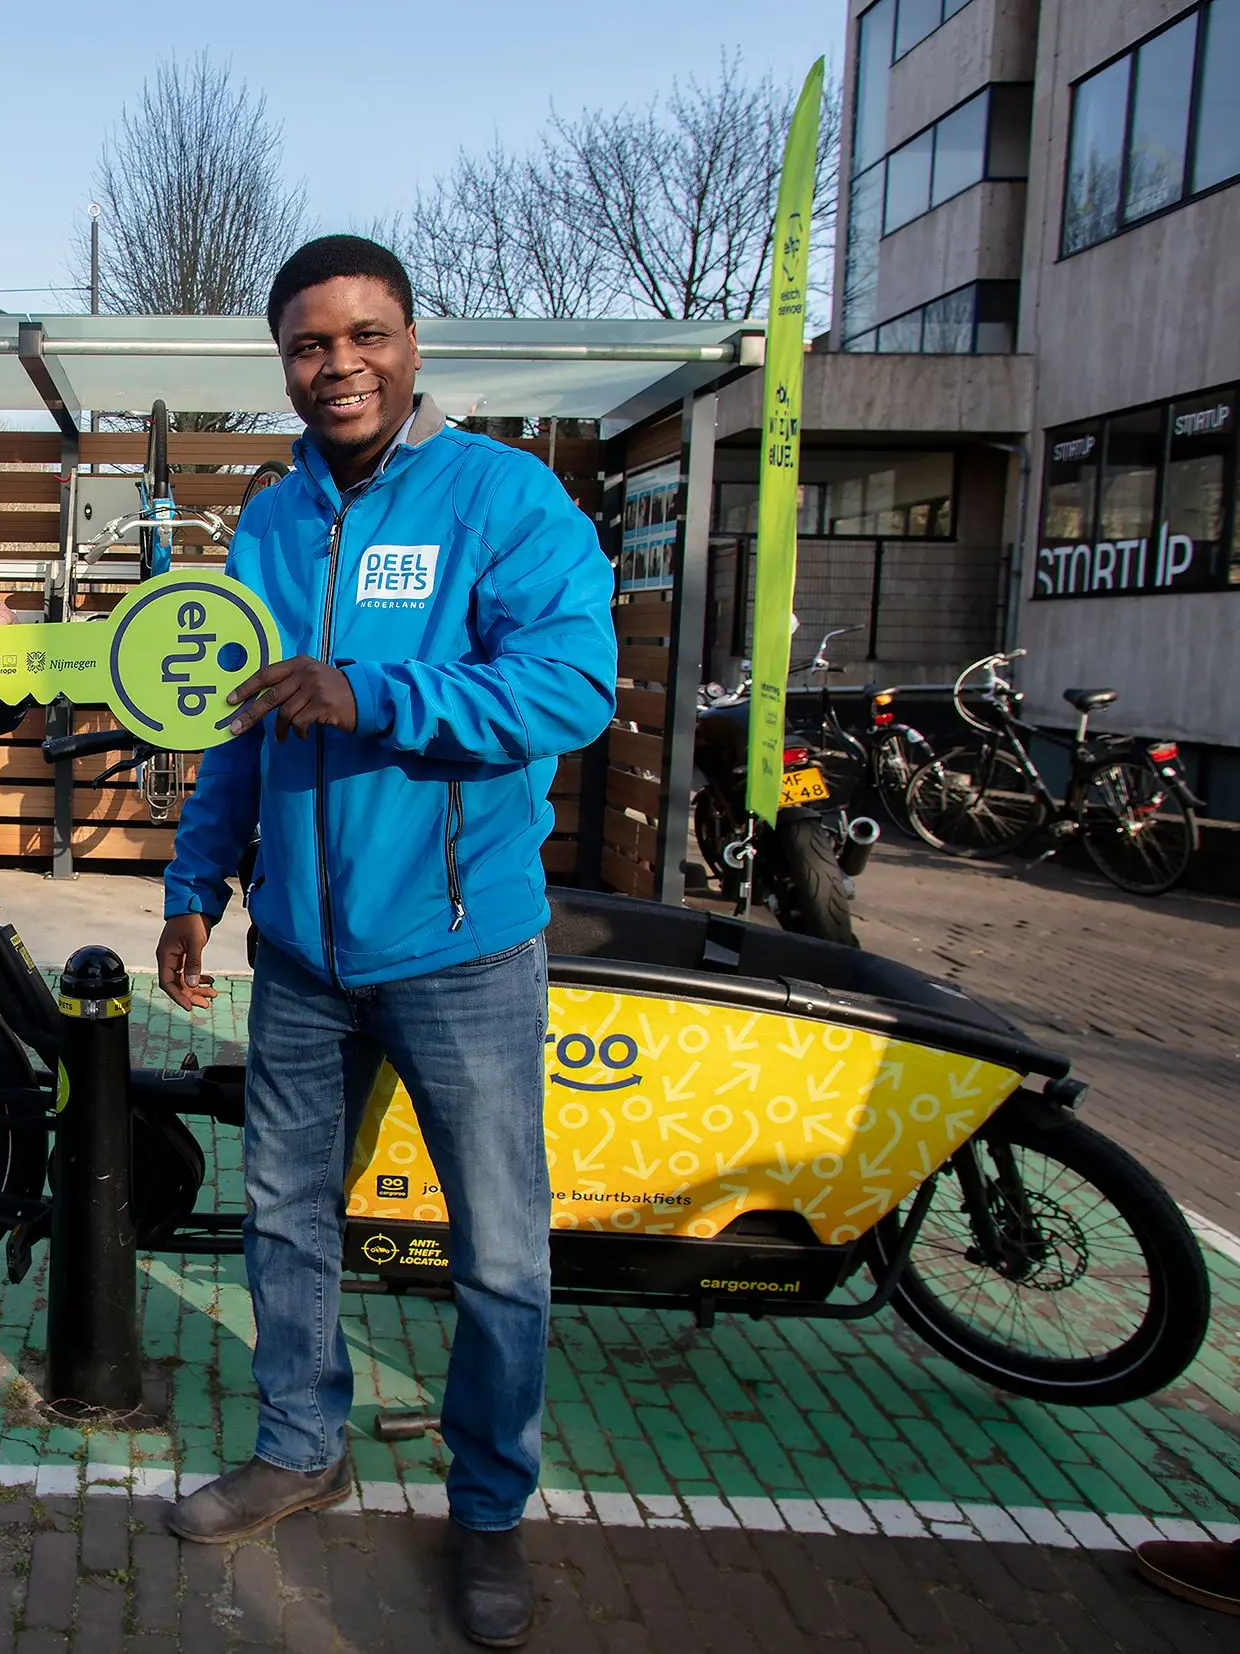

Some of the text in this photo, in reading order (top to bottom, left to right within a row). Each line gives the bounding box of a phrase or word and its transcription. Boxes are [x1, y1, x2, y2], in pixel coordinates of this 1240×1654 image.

[366, 553, 428, 572] DEEL
[364, 572, 428, 591] FIETS
[360, 600, 426, 609] NEDERLAND
[49, 659, 97, 671] Nijmegen
[161, 601, 217, 717] ehub
[780, 784, 824, 804] X-48
[572, 1189, 692, 1206] buurtbakfiets
[409, 1239, 440, 1248] ANTI-
[408, 1248, 442, 1257] THEFT
[400, 1257, 449, 1267] LOCATOR
[700, 1278, 801, 1292] cargoroo.nl
